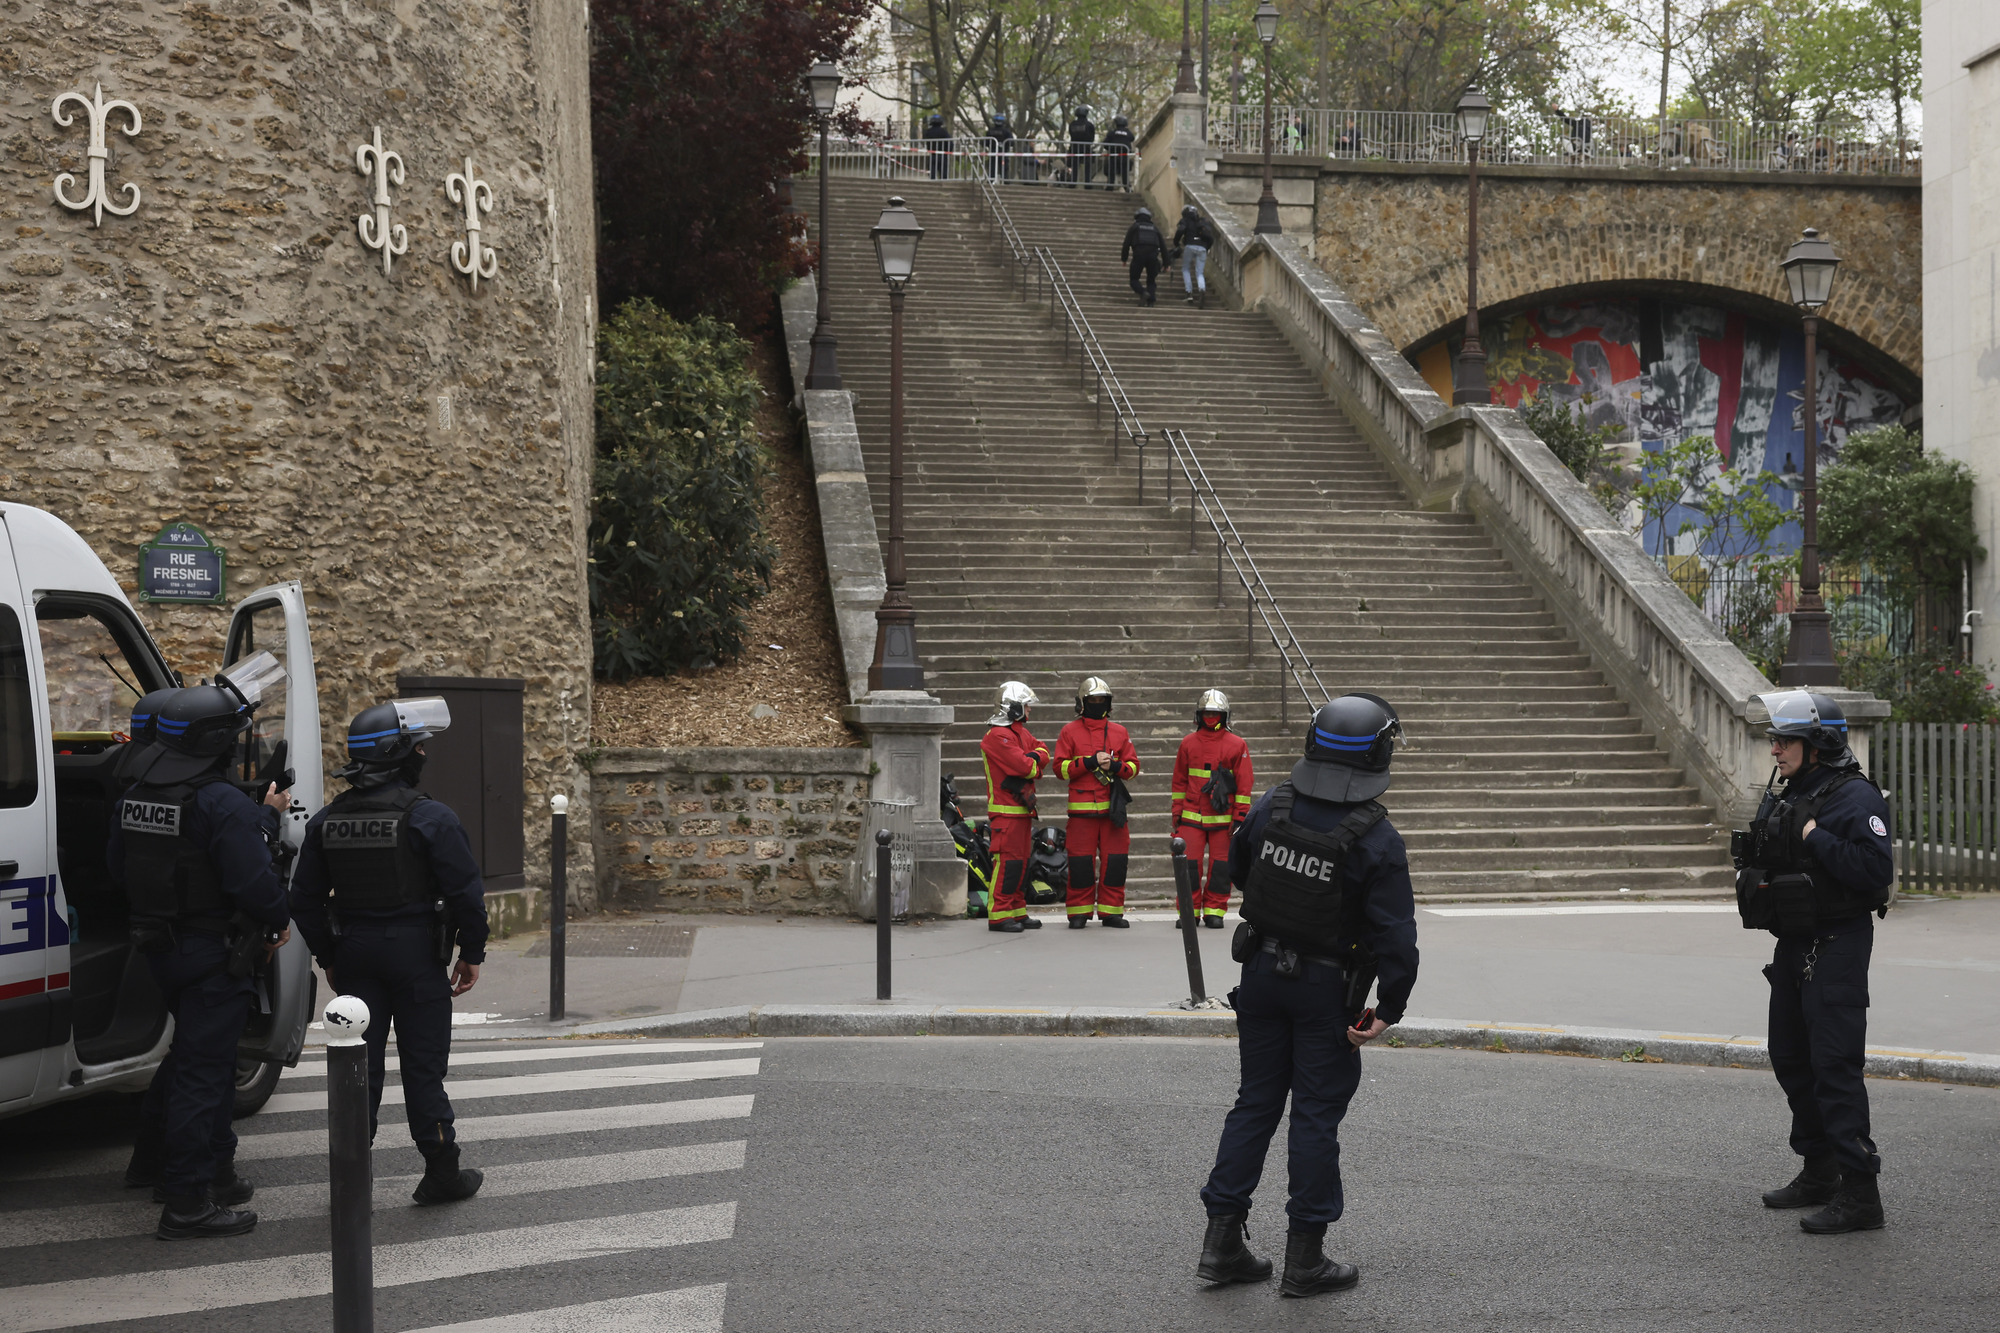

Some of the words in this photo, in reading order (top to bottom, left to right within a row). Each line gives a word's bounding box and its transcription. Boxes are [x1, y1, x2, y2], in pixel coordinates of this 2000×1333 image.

[170, 553, 196, 565] RUE
[153, 567, 212, 581] FRESNEL
[123, 803, 175, 826] POLICE
[325, 821, 393, 838] POLICE
[1260, 840, 1334, 882] POLICE
